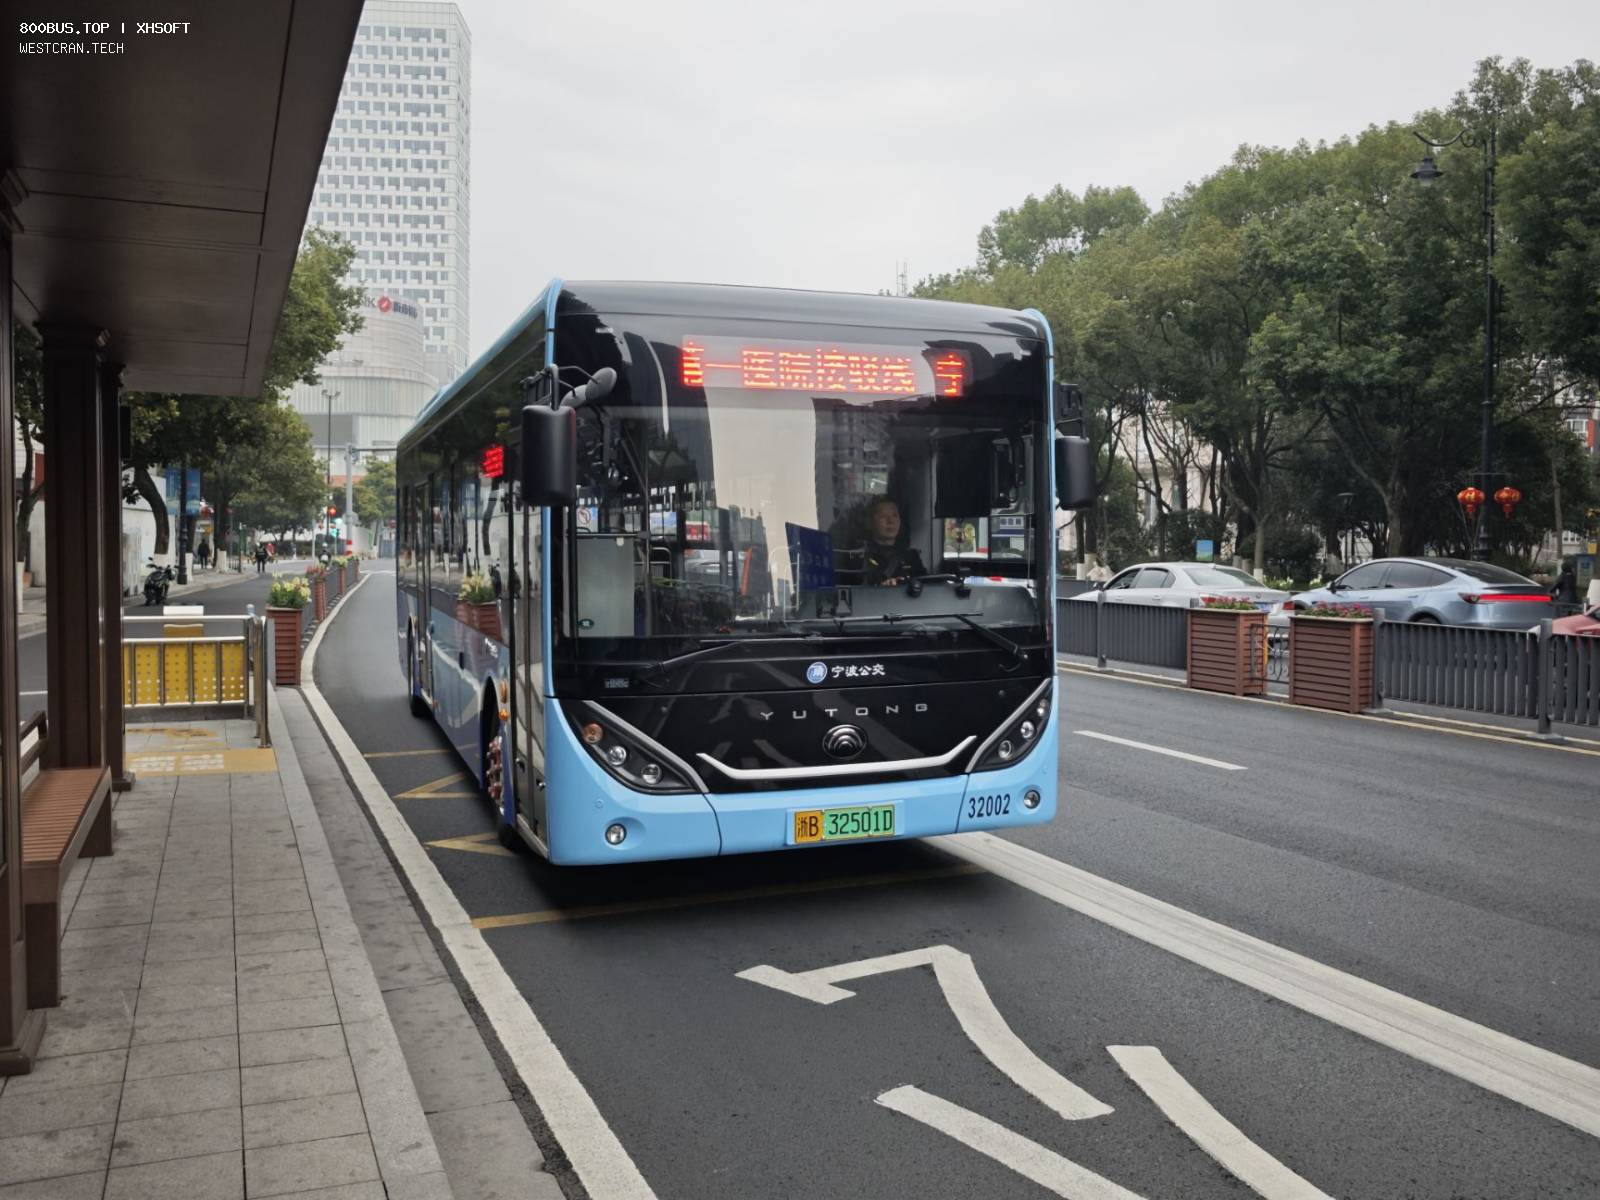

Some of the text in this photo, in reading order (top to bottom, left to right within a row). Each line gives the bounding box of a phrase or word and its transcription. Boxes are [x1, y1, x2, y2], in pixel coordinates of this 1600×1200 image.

[831, 663, 886, 679] 宁波公交
[760, 703, 928, 720] YUTONG
[968, 793, 1010, 819] 32002
